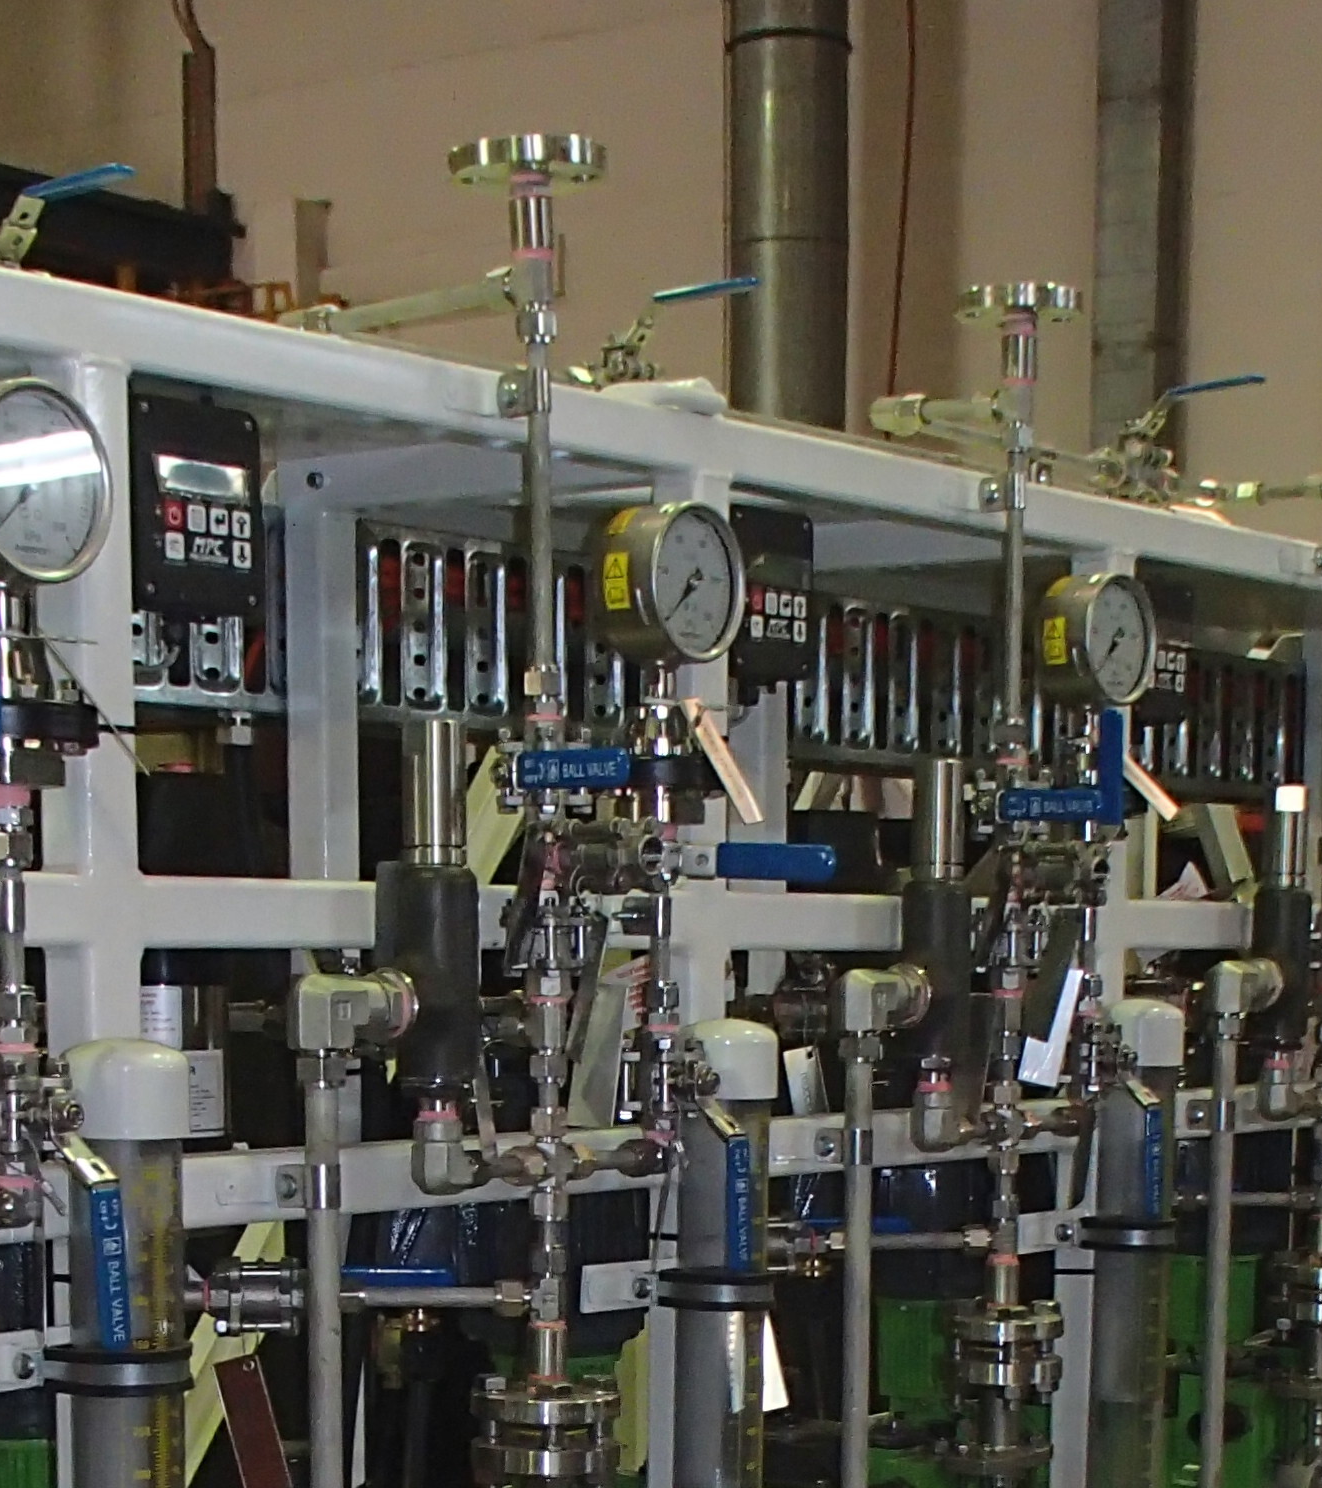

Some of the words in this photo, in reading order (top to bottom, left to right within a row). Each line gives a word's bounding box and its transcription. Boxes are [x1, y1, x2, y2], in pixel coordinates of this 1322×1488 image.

[562, 763, 585, 778] BALL
[586, 761, 617, 776] VALVE
[738, 1197, 747, 1224] BALL
[108, 1261, 122, 1294] BALL
[111, 1298, 126, 1342] VALVE
